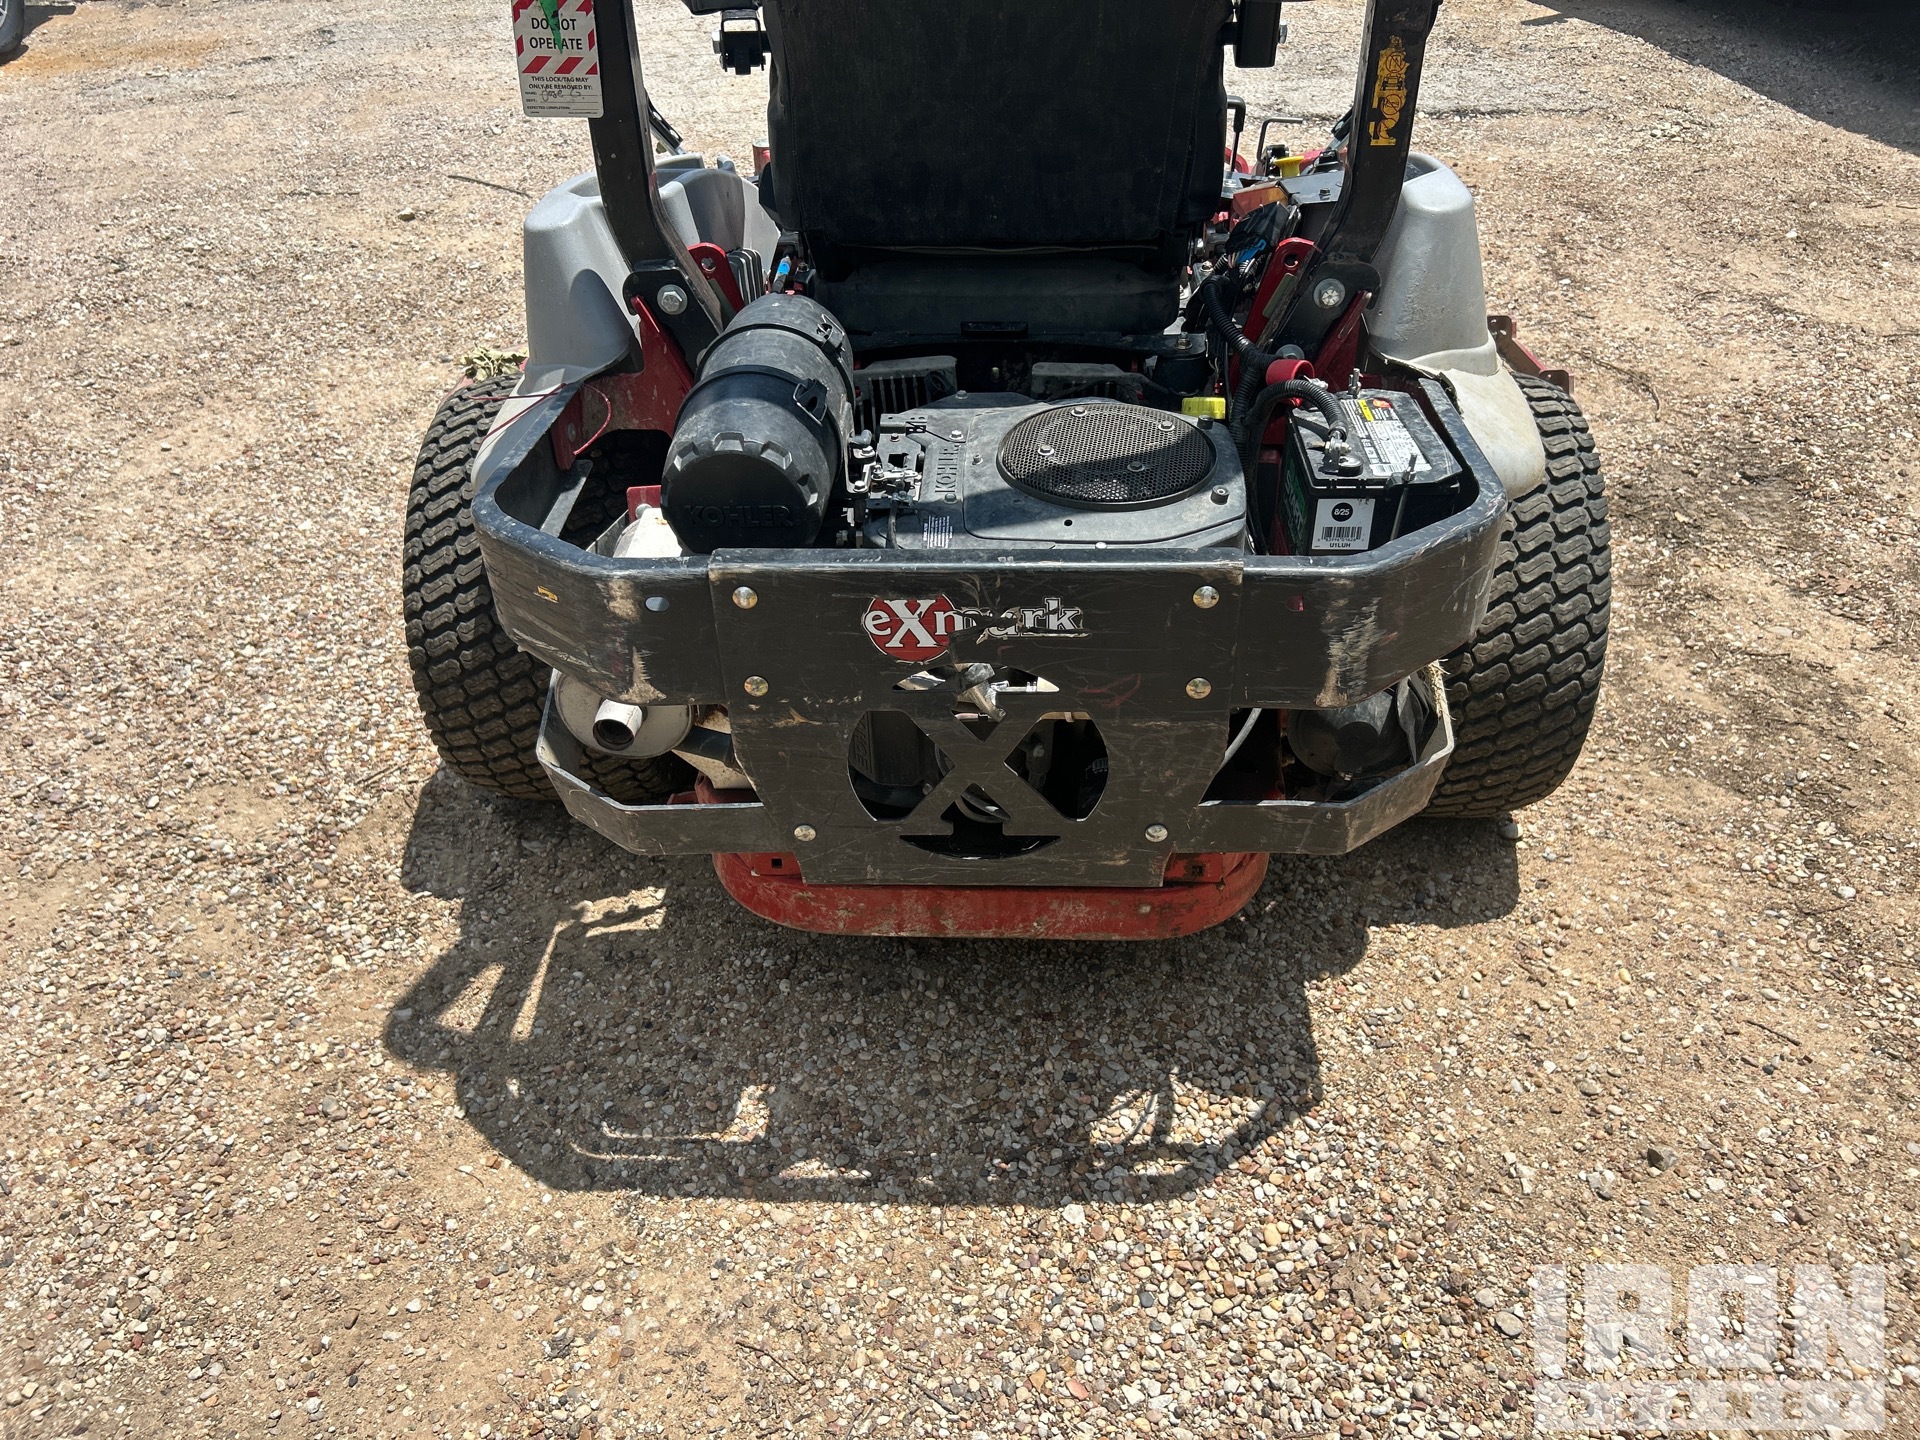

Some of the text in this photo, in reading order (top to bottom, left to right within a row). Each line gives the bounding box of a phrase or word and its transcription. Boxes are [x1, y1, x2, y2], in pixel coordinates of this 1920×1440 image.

[531, 17, 577, 31] DO OT
[684, 504, 795, 528] KOHLER
[1333, 508, 1350, 516] 8/25
